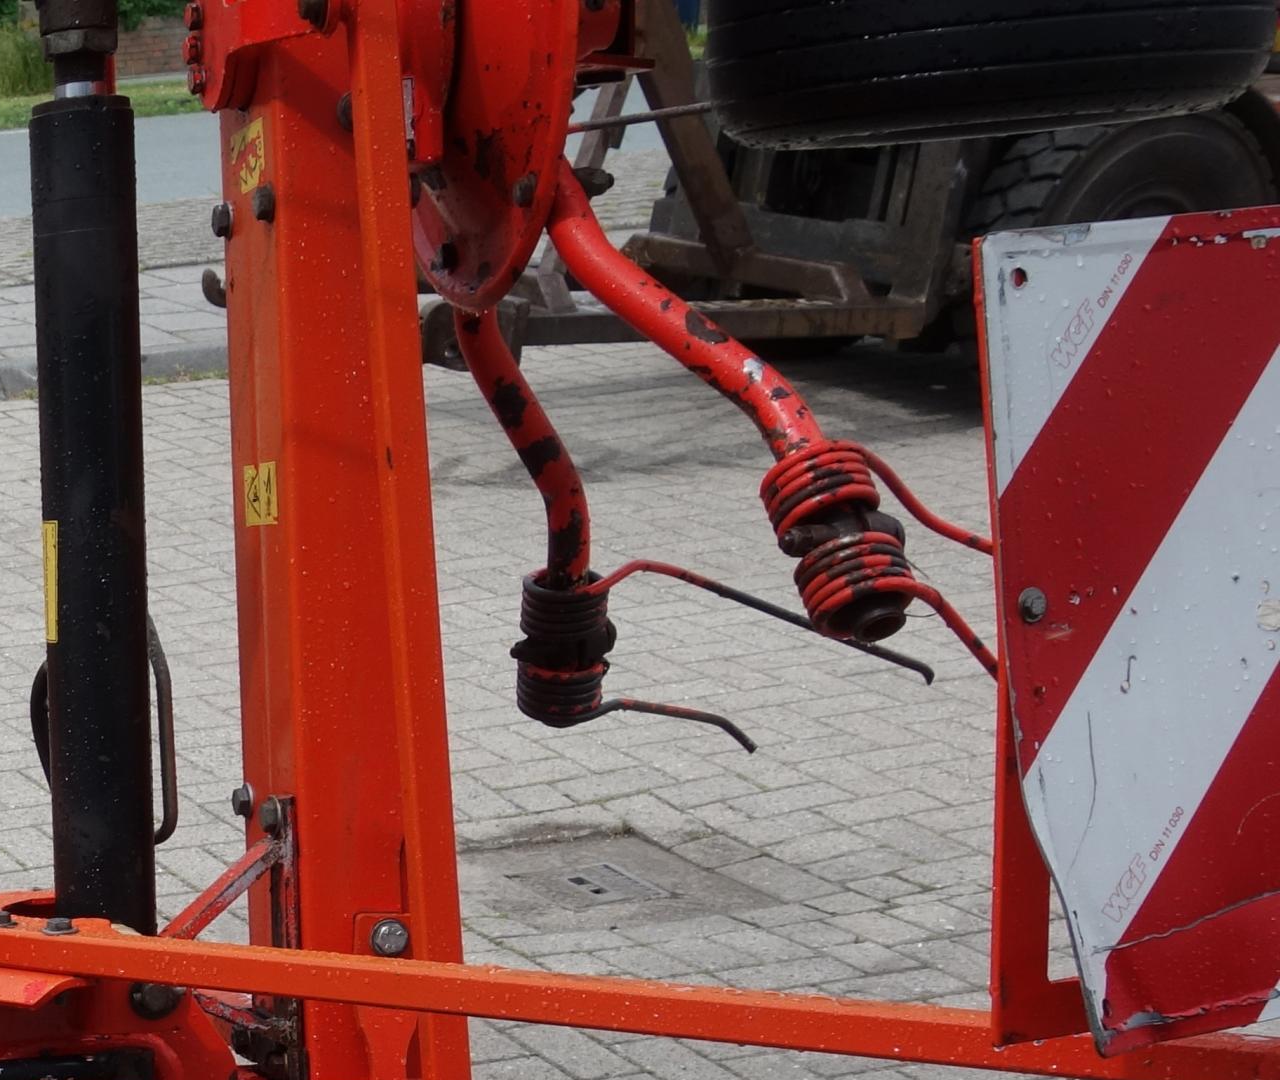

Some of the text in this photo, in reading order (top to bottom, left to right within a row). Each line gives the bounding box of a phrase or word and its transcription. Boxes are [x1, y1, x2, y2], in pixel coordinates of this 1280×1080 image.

[1096, 285, 1114, 309] DIN
[1117, 253, 1133, 275] 030
[1148, 838, 1166, 862] DIN
[1168, 805, 1185, 829] 030
